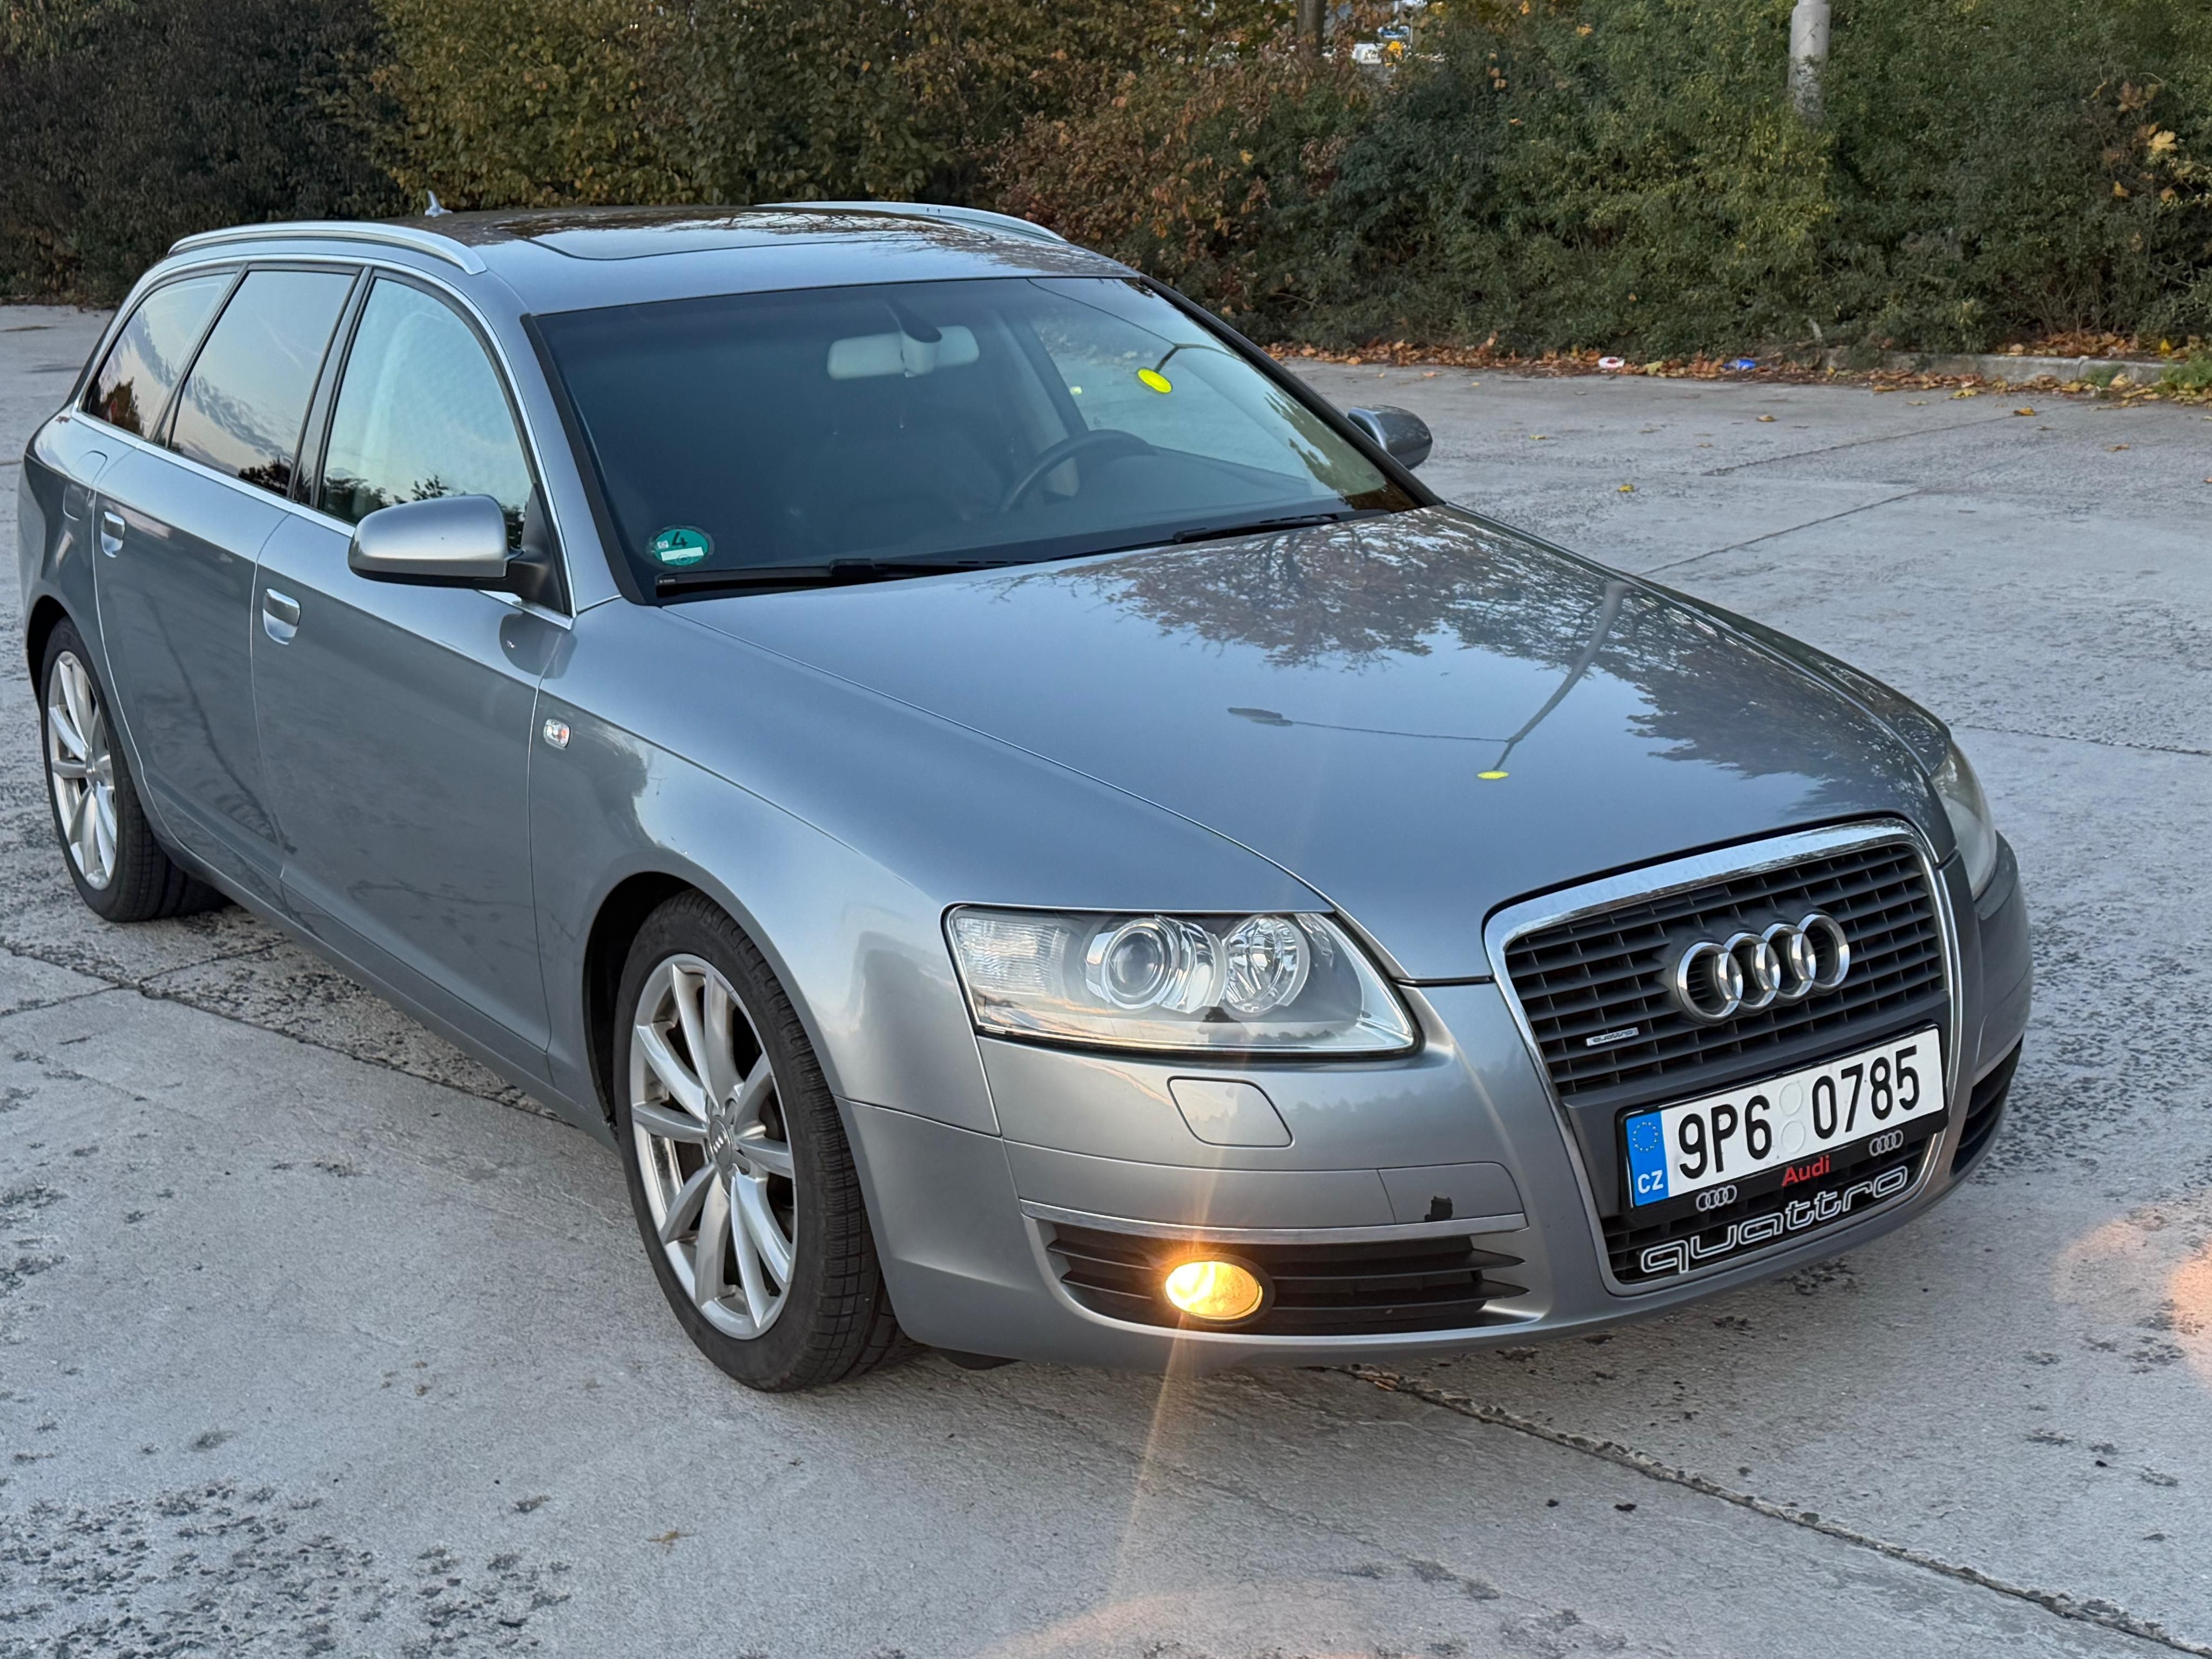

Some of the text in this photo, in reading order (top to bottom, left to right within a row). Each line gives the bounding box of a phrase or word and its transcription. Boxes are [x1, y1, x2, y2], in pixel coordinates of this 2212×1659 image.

[672, 531, 687, 547] 4
[1679, 1045, 1919, 1179] 9P6 0785
[1638, 1170, 1663, 1193] CZ
[1782, 1155, 1830, 1187] Audi
[1641, 1165, 1908, 1273] quattro
